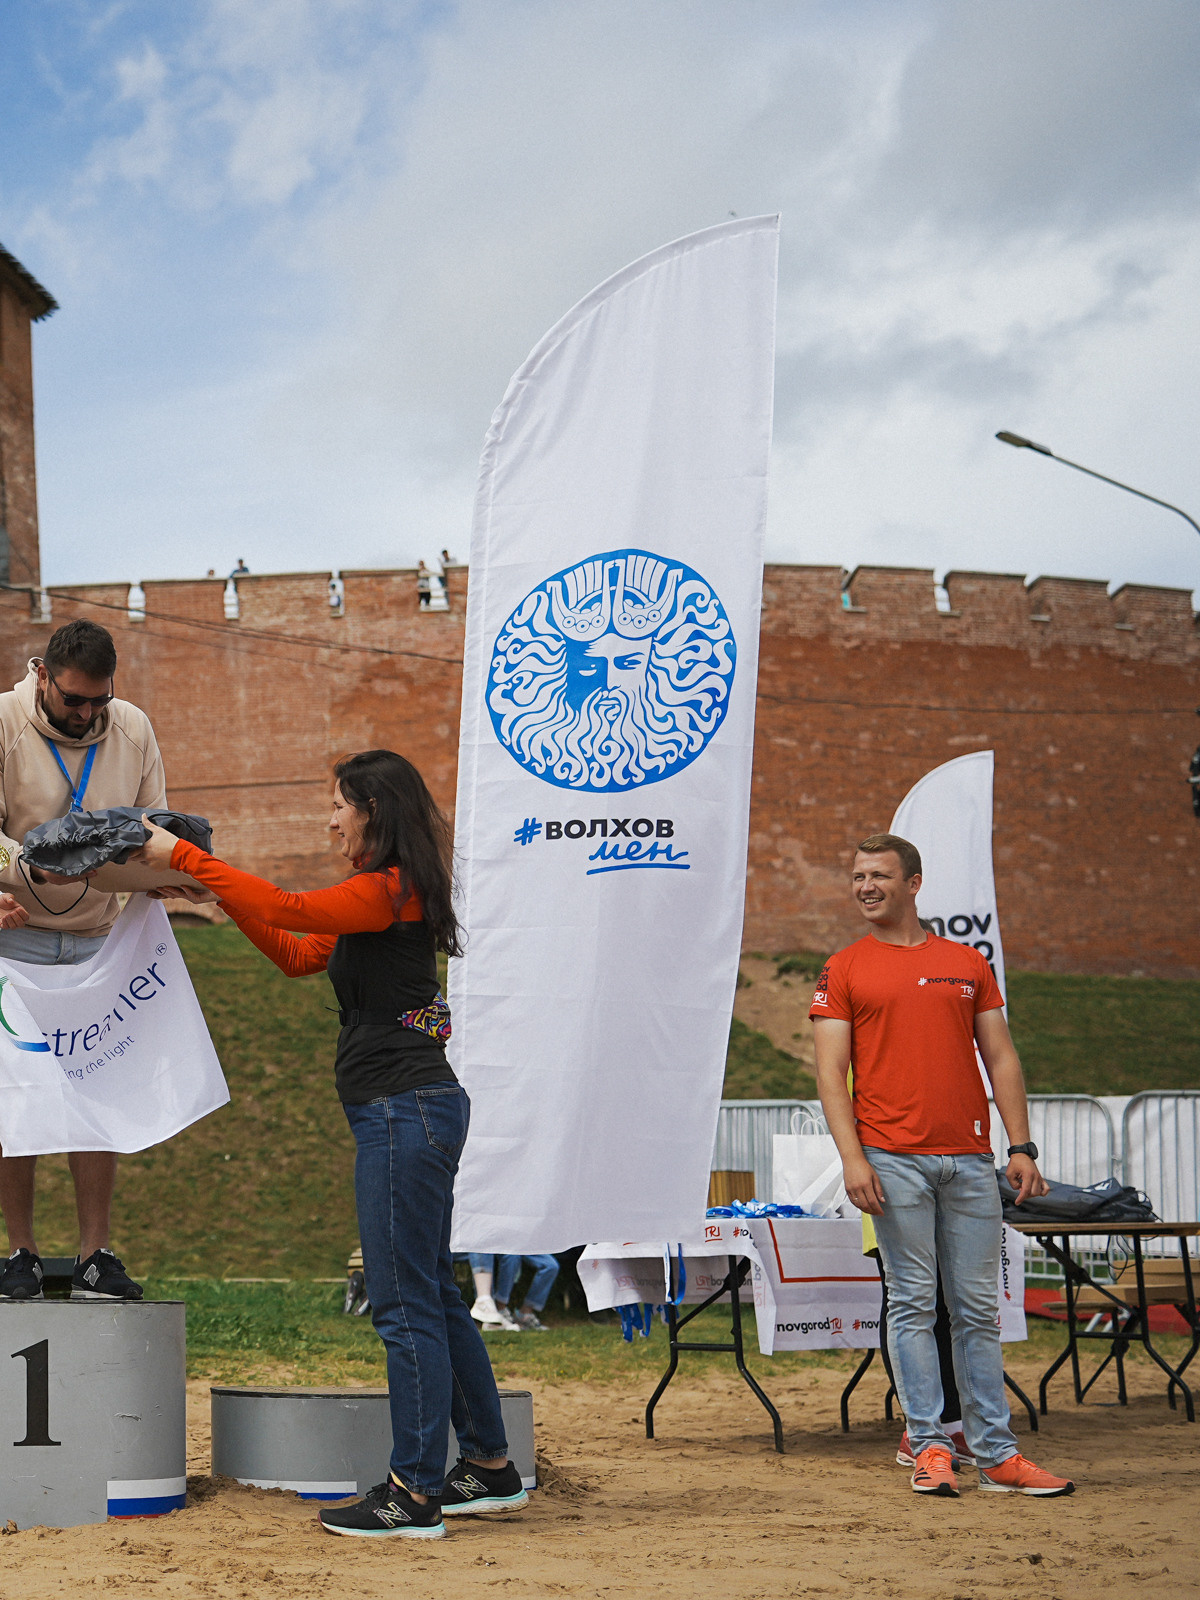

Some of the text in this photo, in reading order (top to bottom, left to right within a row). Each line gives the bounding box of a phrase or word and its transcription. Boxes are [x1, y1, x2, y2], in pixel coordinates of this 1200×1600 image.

[513, 817, 675, 846] #ВОЛХОВ
[103, 1035, 136, 1061] light
[11, 1339, 61, 1446] 1
